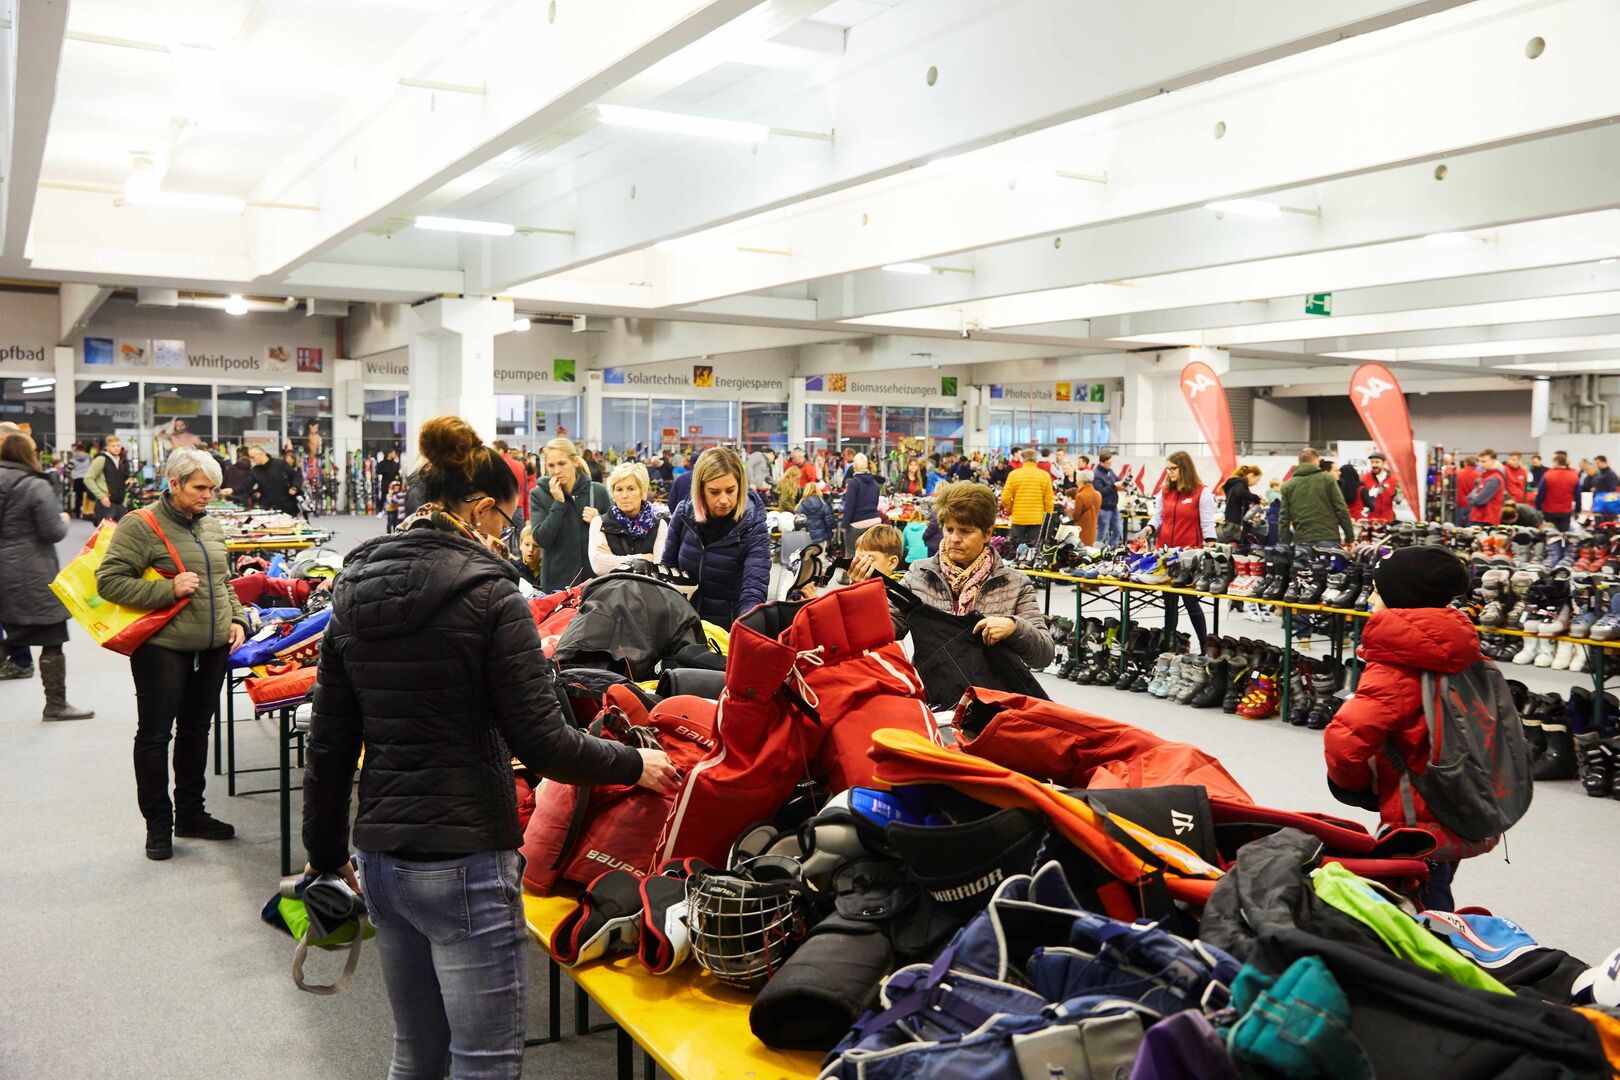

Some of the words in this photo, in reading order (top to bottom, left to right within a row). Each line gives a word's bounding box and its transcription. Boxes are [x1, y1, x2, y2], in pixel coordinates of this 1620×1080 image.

[0, 346, 45, 360] pfbad
[188, 355, 260, 371] Whirlpools
[366, 362, 409, 375] Wellne
[494, 370, 548, 382] epumpen
[627, 372, 690, 385] Solartechnik
[715, 376, 783, 390] Energiesparen
[851, 382, 937, 398] Biomasseheizungen
[1005, 388, 1053, 399] Photovoltaik
